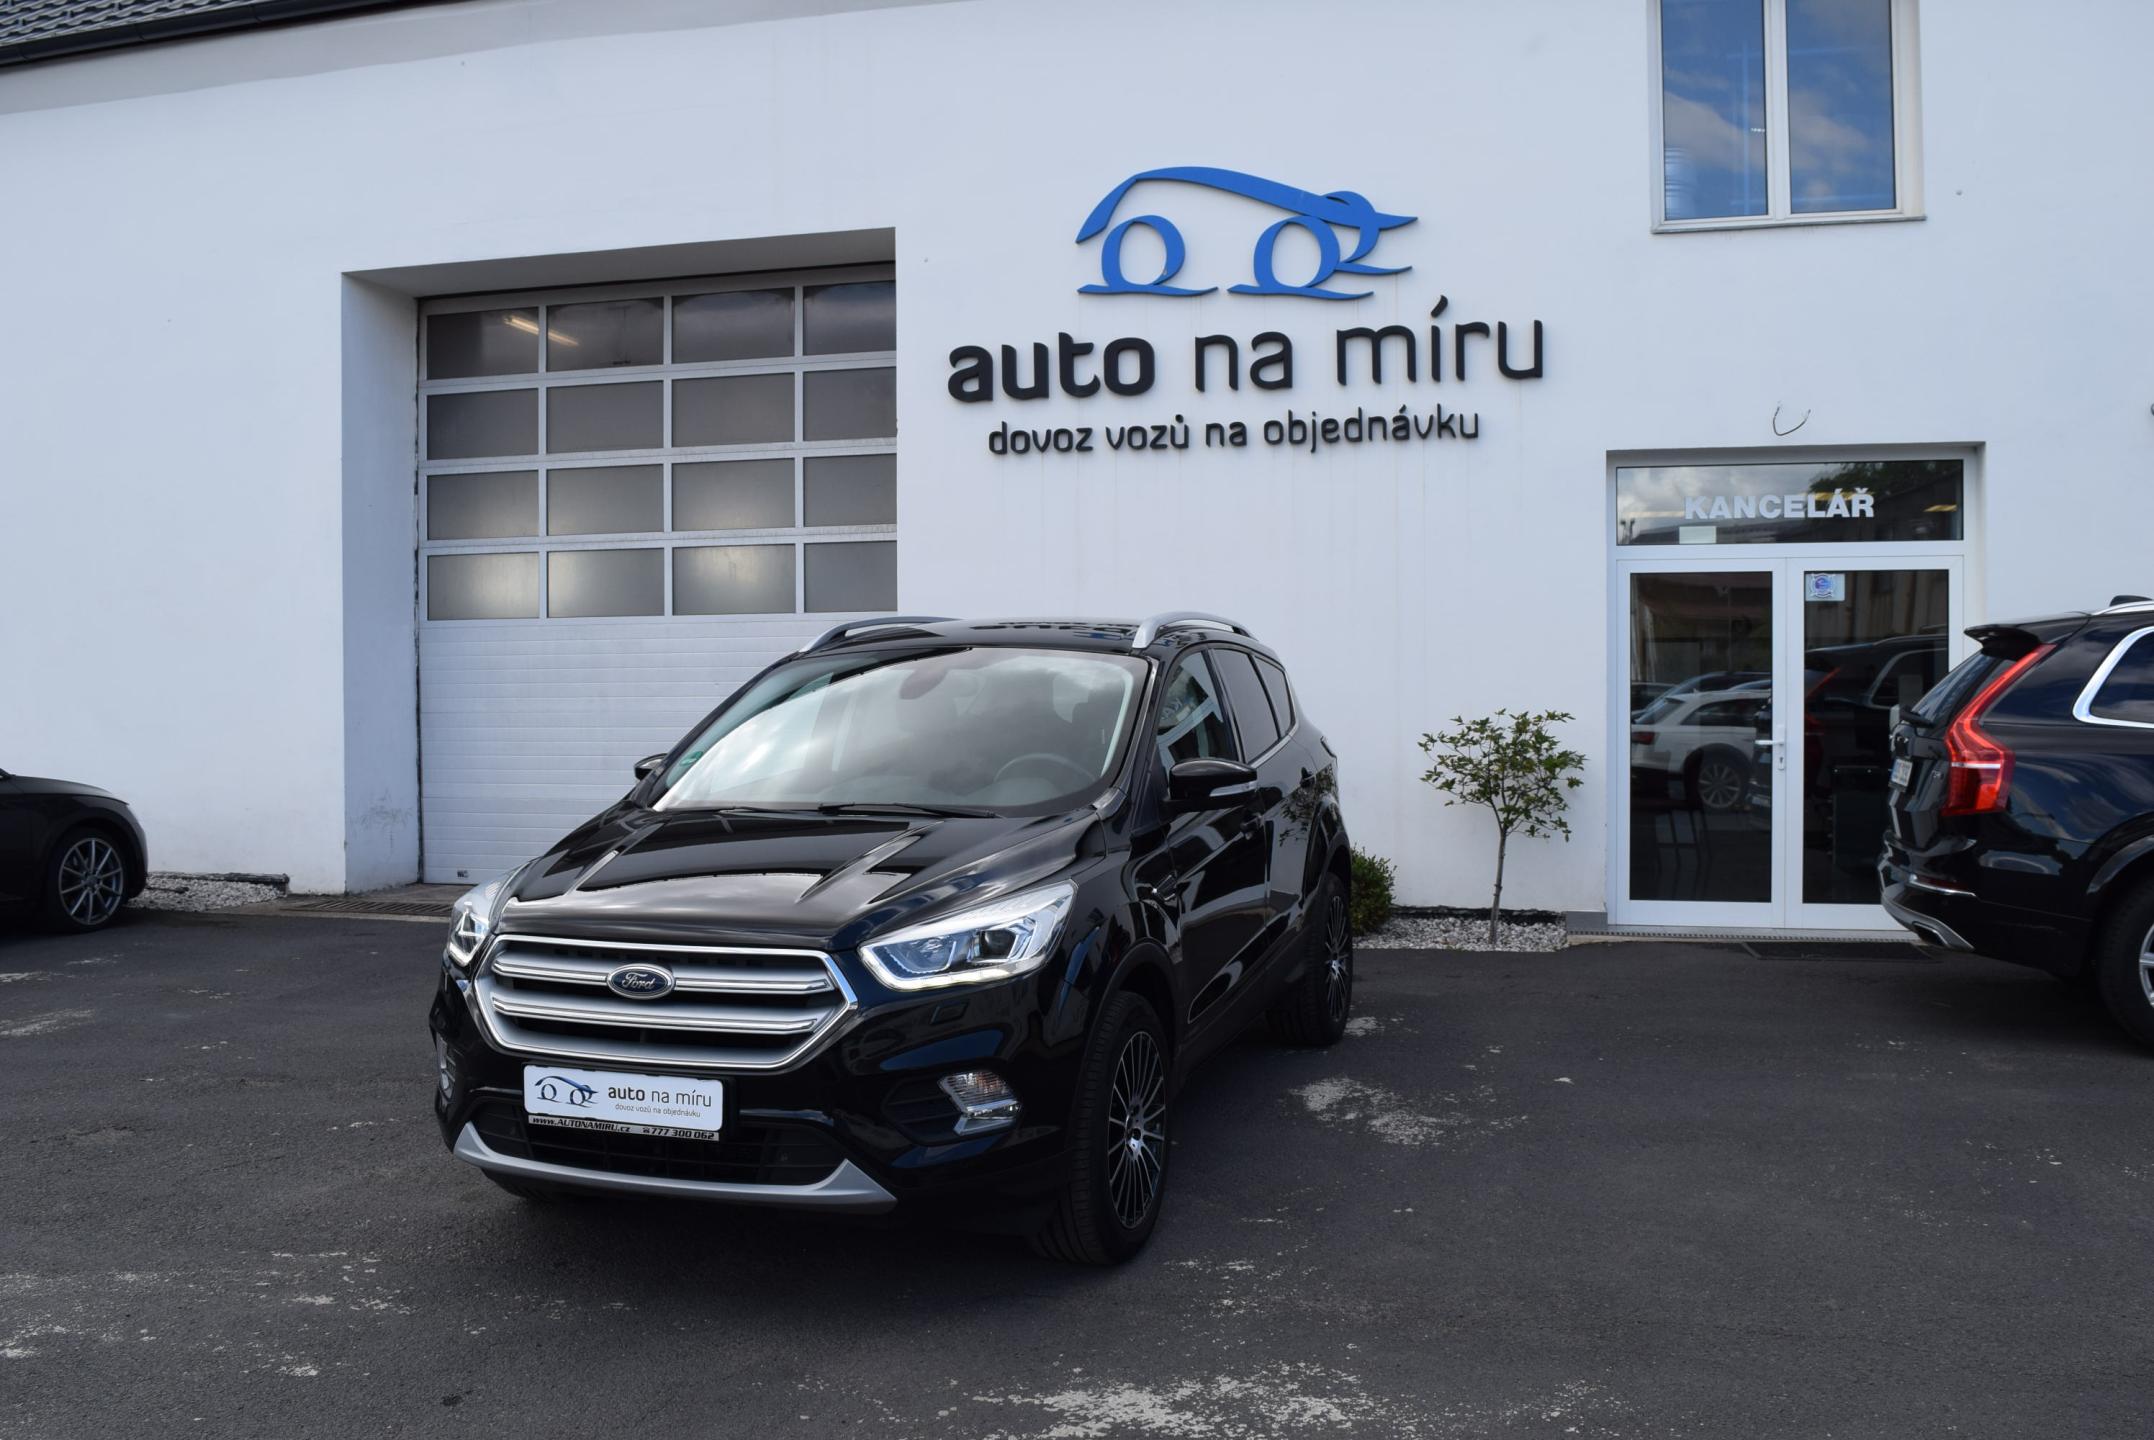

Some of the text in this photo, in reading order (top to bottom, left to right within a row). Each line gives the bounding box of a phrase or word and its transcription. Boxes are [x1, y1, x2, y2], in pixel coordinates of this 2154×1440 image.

[948, 295, 1545, 404] auto na míru
[988, 403, 1480, 456] dovoz vozů na objednávku
[1684, 487, 1876, 520] KANCELÁŘ
[621, 972, 656, 990] Ford
[608, 1086, 712, 1107] auto na míru
[651, 1126, 669, 1136] 777
[671, 1130, 692, 1138] 300
